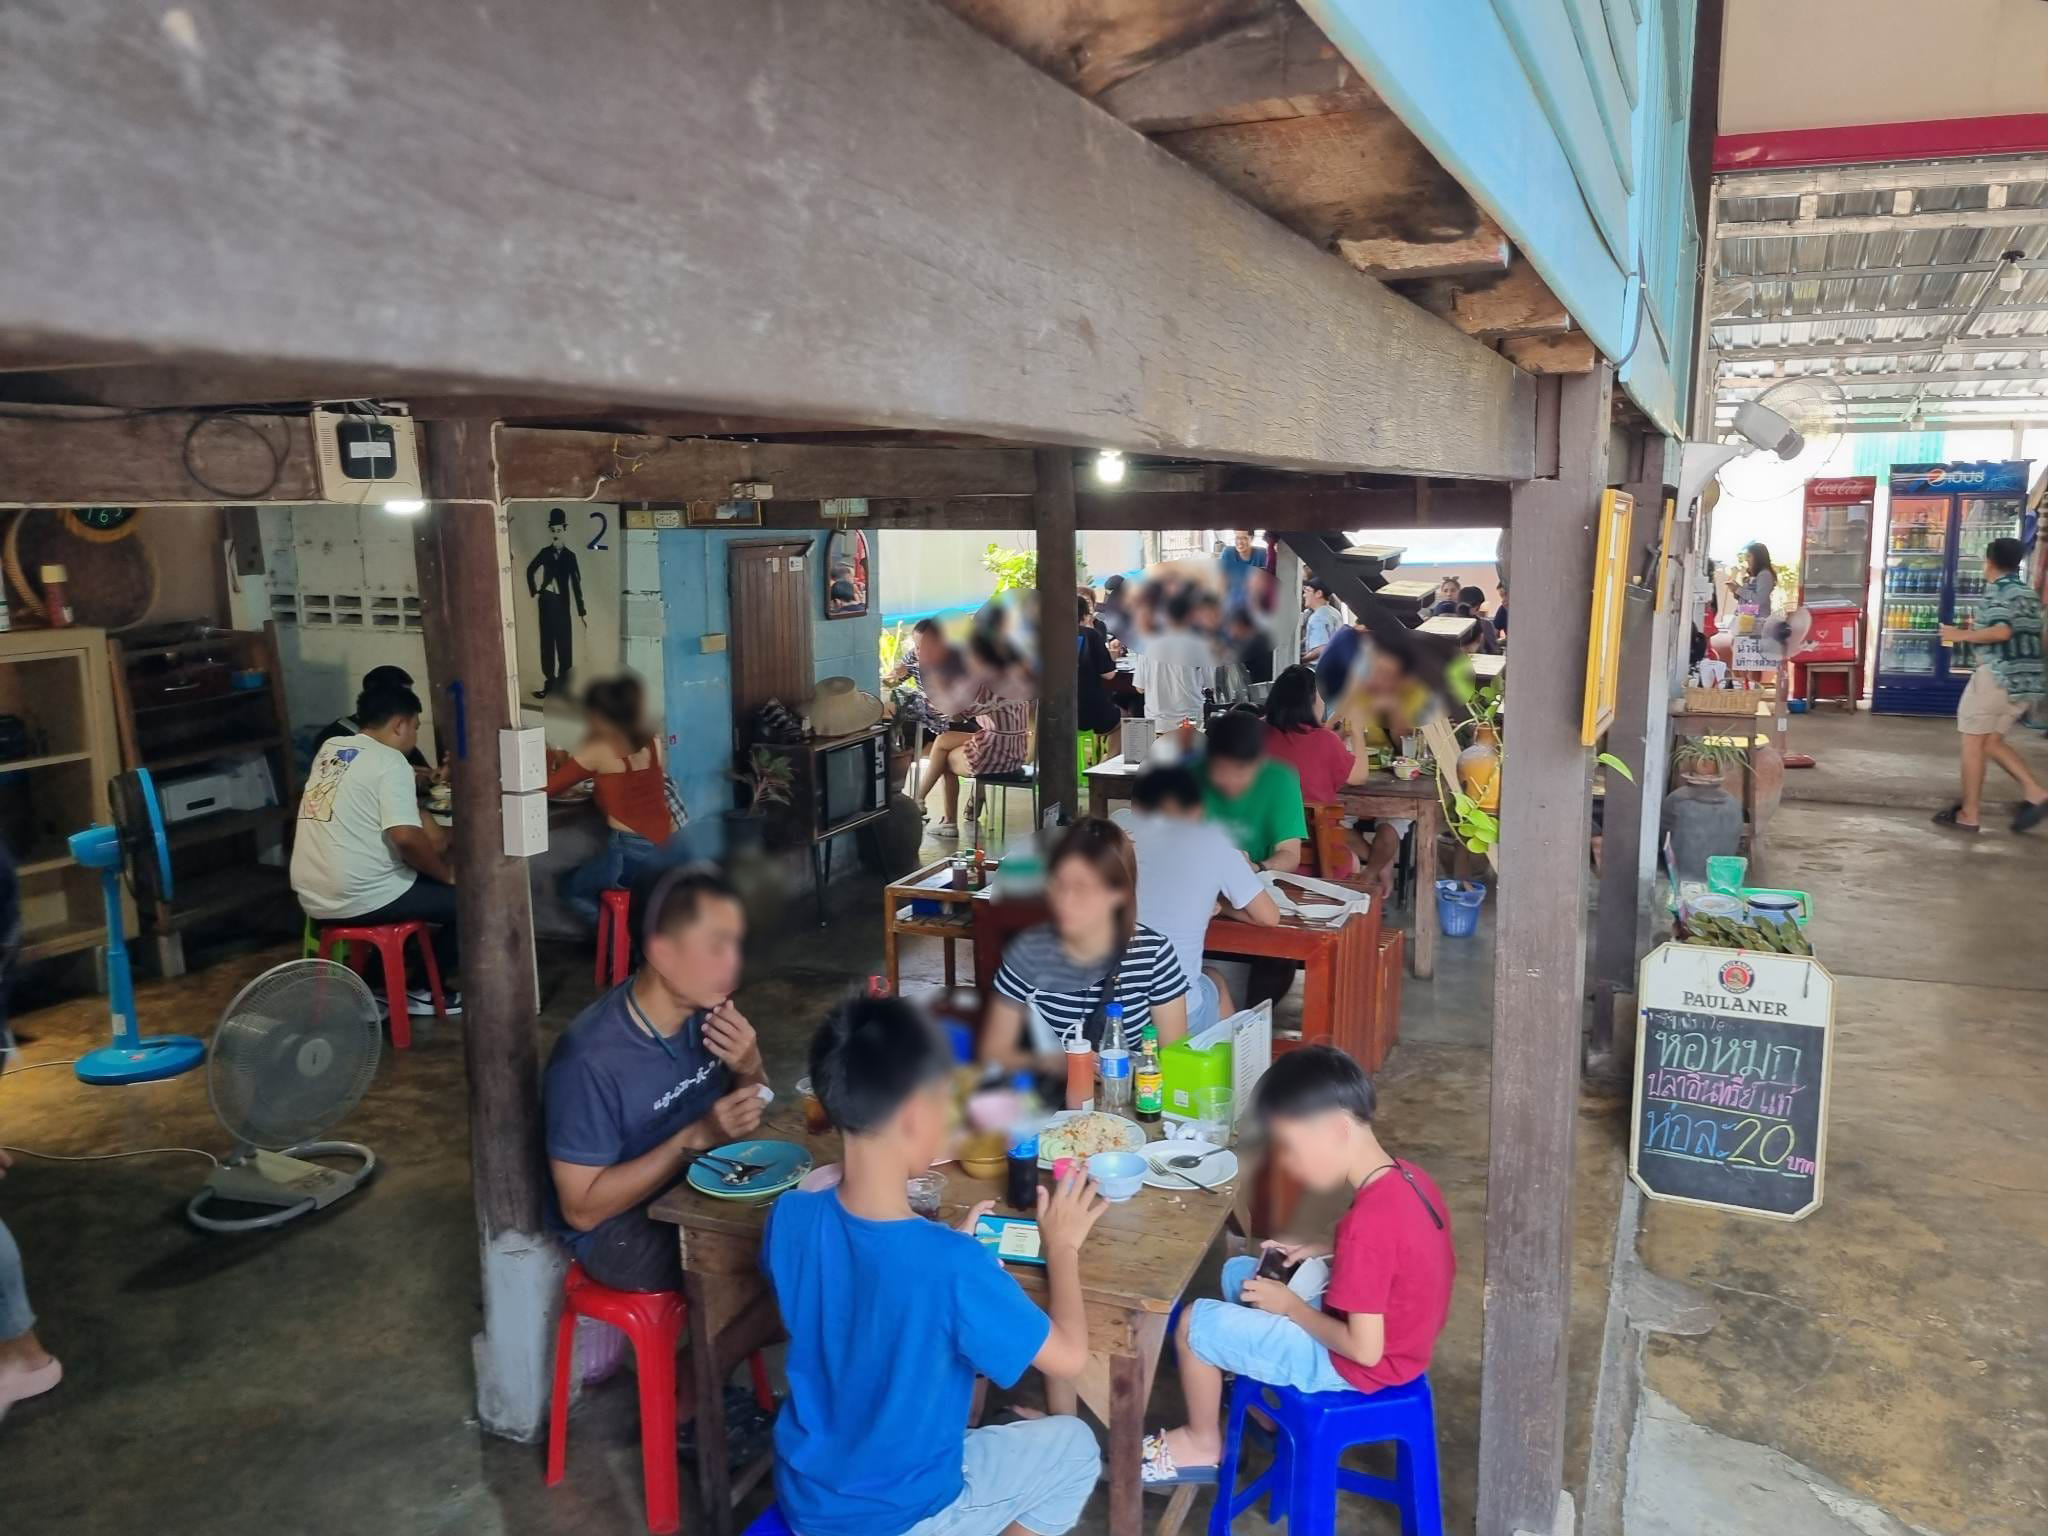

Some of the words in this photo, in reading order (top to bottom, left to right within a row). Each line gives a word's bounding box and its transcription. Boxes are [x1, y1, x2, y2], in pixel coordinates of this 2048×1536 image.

[587, 512, 609, 550] 2
[448, 679, 467, 758] 1
[1683, 991, 1788, 1016] PAULANER
[1725, 1118, 1795, 1165] 20
